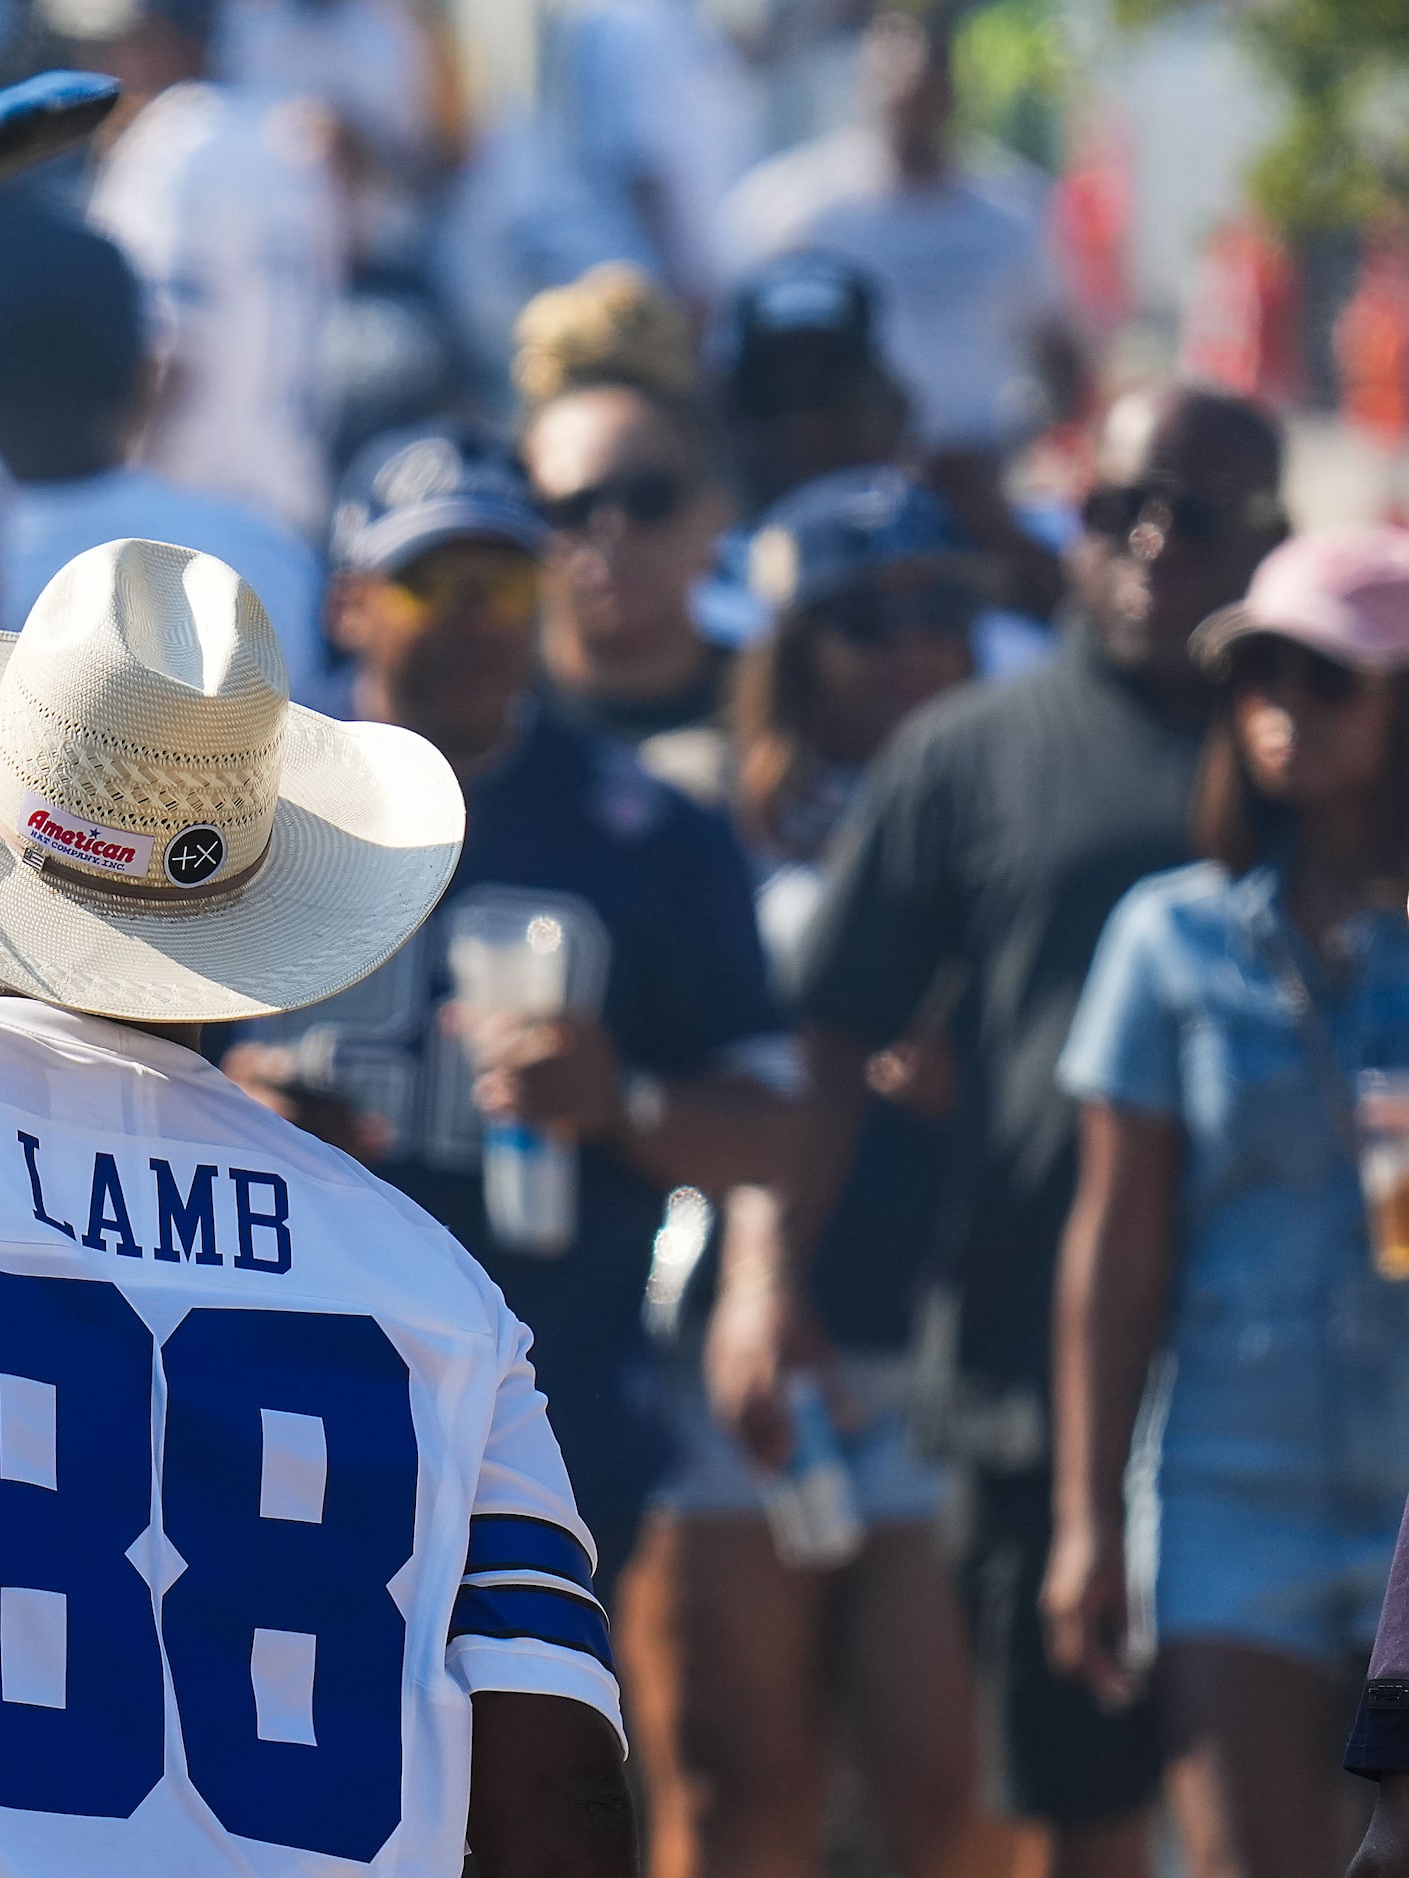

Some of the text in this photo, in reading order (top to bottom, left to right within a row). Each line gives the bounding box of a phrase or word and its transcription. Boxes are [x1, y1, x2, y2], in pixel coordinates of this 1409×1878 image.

[27, 809, 137, 864] American
[30, 829, 51, 845] HAT
[101, 859, 126, 871] INC.
[18, 1130, 292, 1275] LAMB
